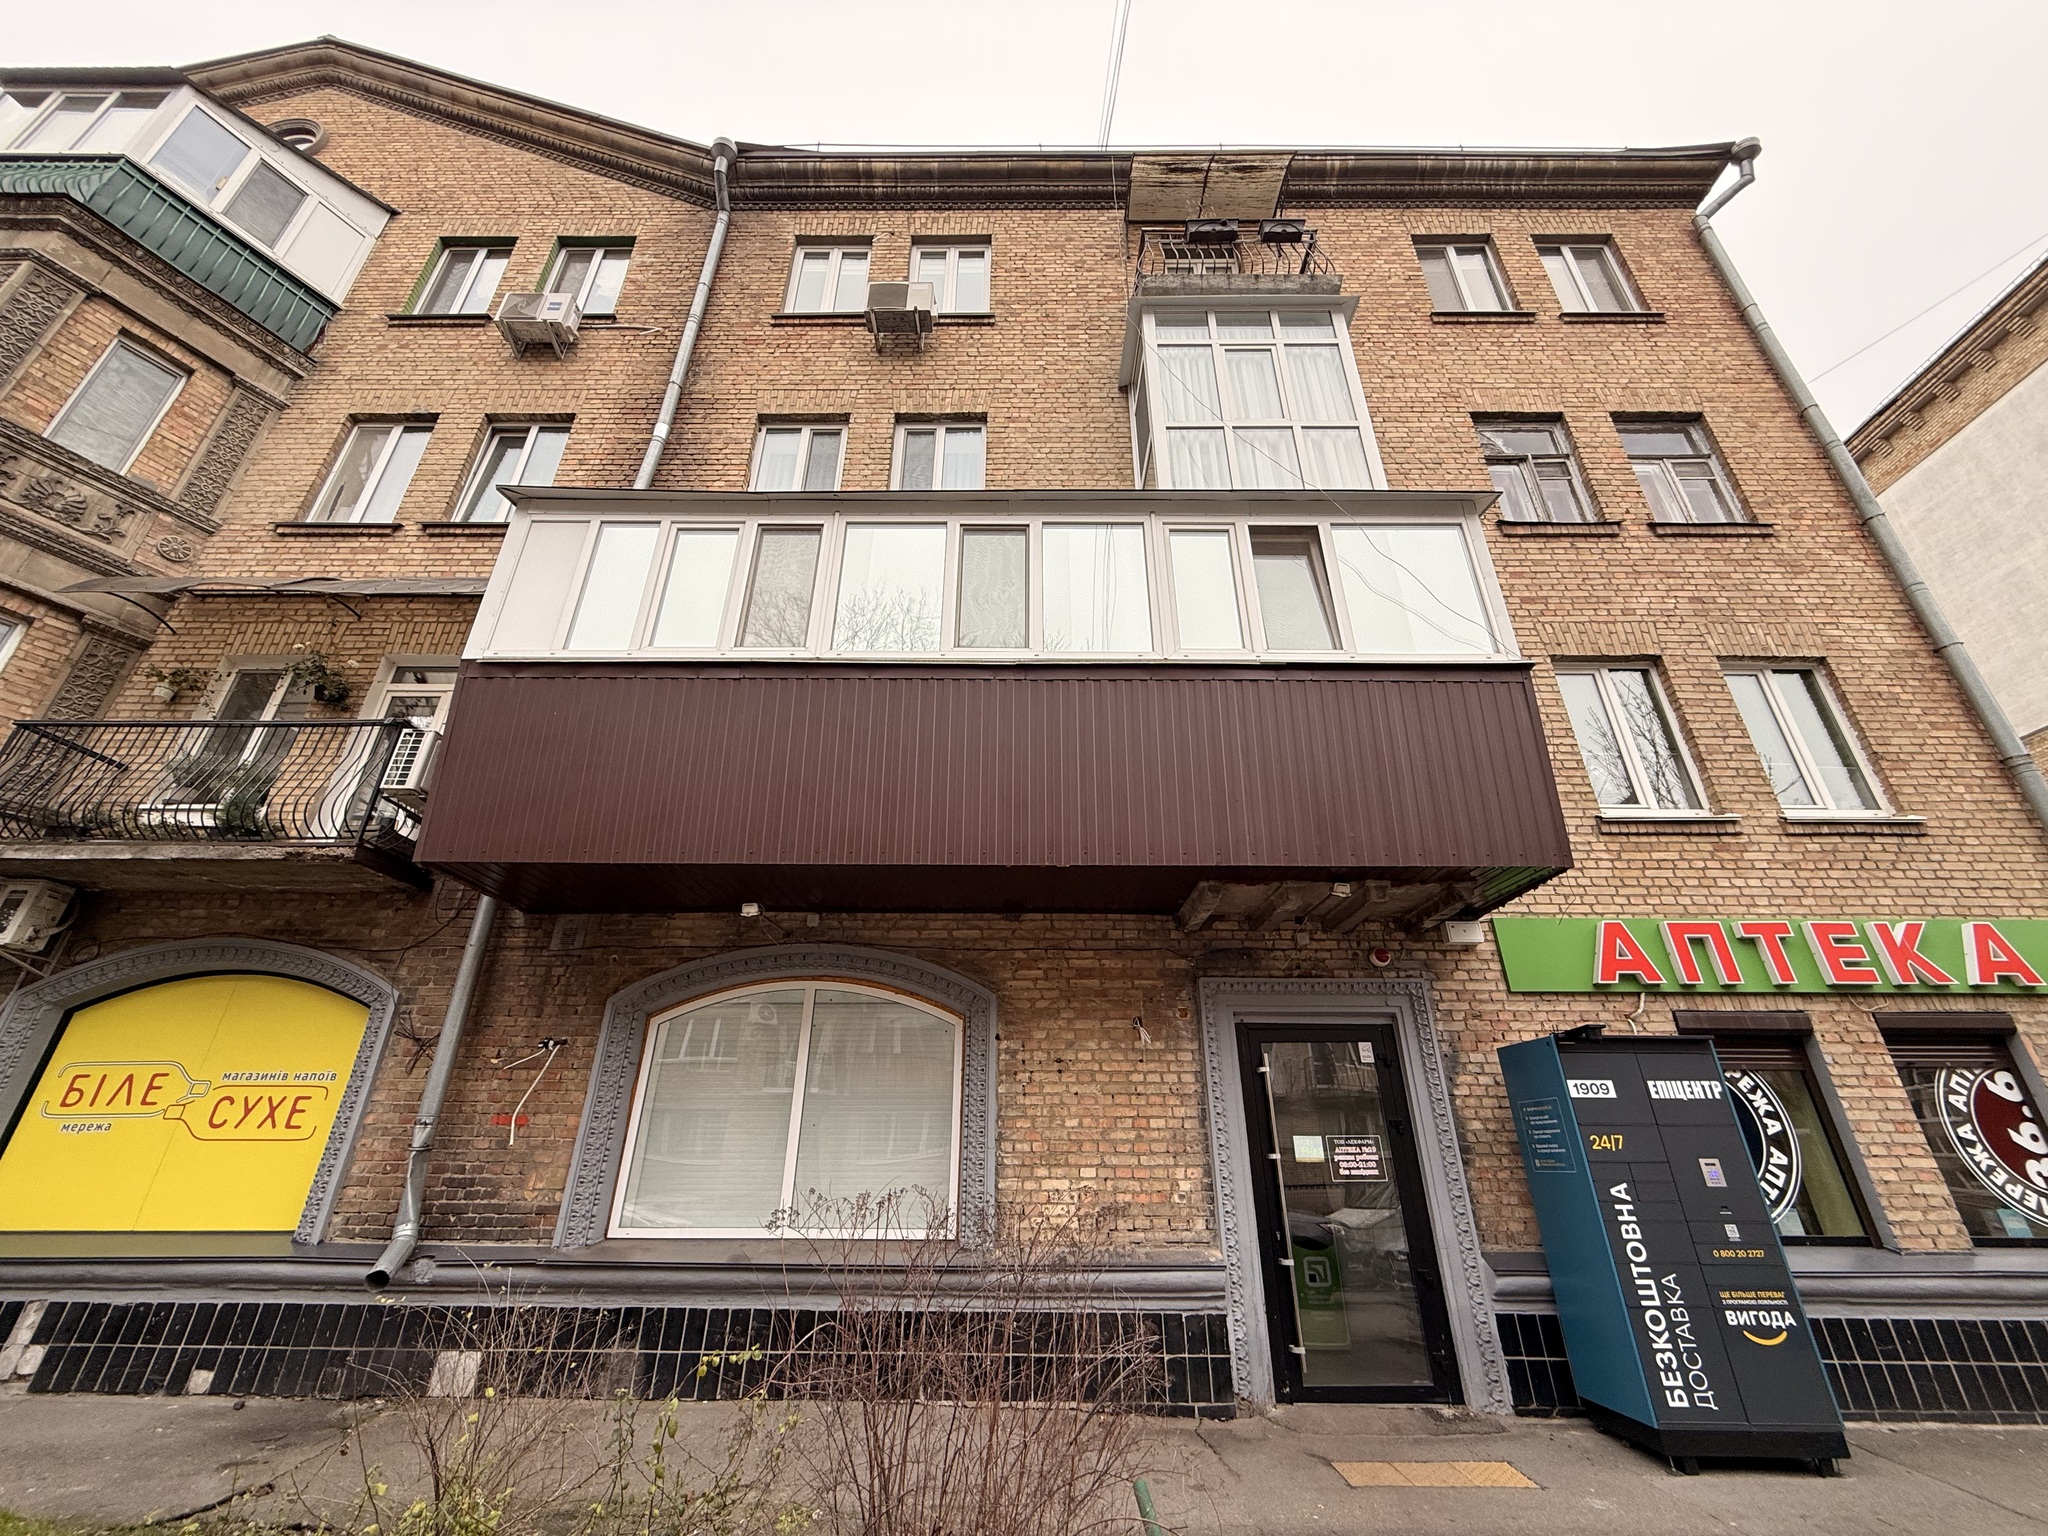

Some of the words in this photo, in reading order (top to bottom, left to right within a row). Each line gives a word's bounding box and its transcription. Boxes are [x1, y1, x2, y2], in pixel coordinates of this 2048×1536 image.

[1594, 919, 2046, 985] АПТЕКА
[222, 1070, 288, 1081] магазинів
[293, 1070, 337, 1081] напоїв
[1573, 1082, 1610, 1095] 1909
[59, 1073, 170, 1107] БІЛЕ
[1647, 1080, 1723, 1100] ЕПІЦЕНТР
[208, 1096, 312, 1129] СУХЕ
[60, 1122, 112, 1134] мережа
[1760, 1146, 1789, 1206] АПТ
[1713, 1250, 1720, 1258] 0
[1720, 1250, 1735, 1258] 800
[1736, 1250, 1747, 1258] 20
[1610, 1182, 1691, 1408] БЕЗКОШТОВНА
[1724, 1310, 1798, 1329] ВИГОДА
[1661, 1273, 1719, 1410] ДОСТАВКА
